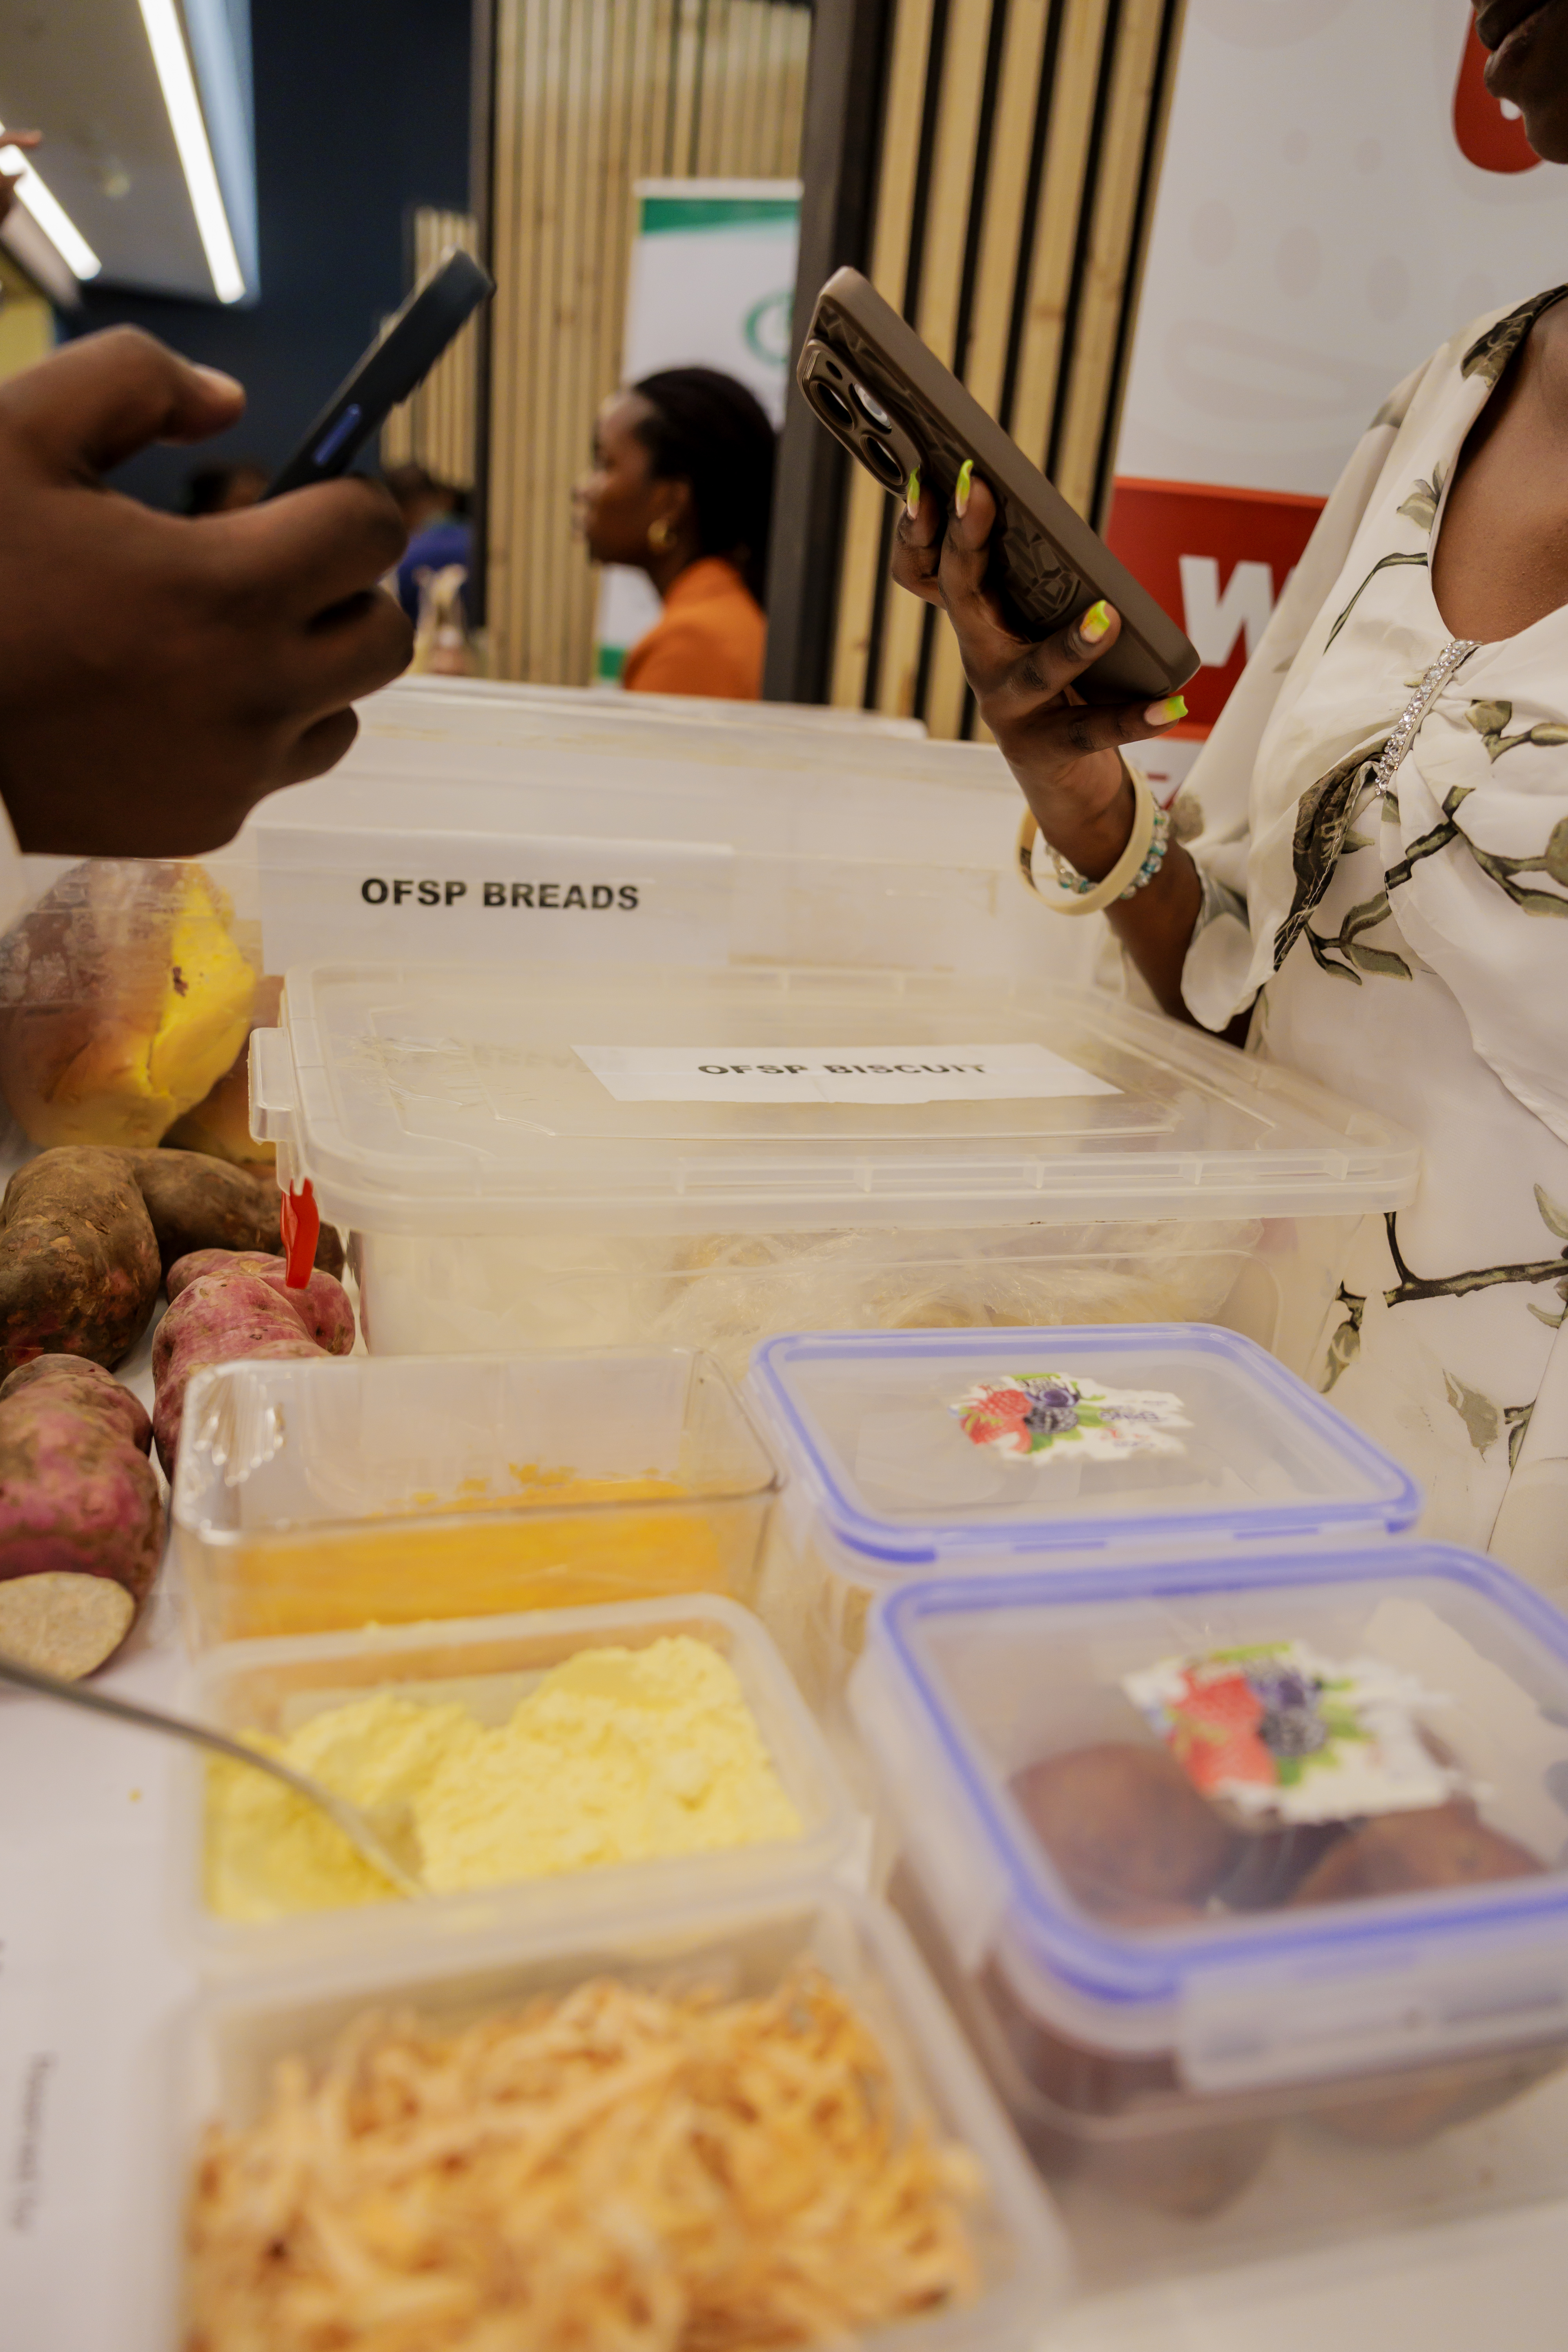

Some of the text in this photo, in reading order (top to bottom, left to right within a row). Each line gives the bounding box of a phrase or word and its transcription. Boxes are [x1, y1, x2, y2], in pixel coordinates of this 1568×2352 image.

[361, 878, 639, 910] OFSP BREADS
[698, 1065, 986, 1074] OFSP BISCUIT
